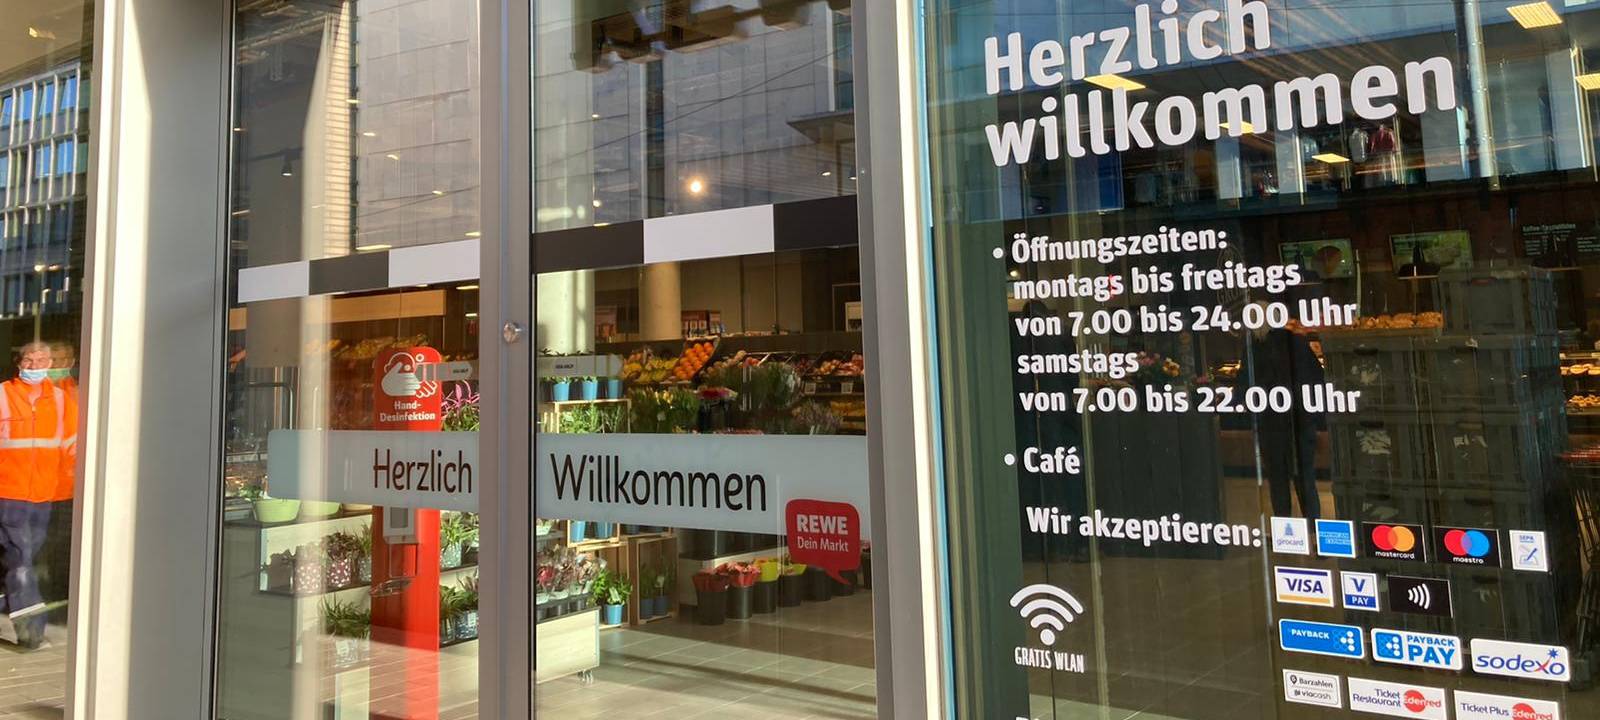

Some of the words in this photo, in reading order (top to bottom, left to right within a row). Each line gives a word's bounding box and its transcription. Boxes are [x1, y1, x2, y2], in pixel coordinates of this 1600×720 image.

[984, 0, 1271, 95] Herzlich
[985, 56, 1456, 167] willkommen
[1011, 226, 1228, 265] Öffnungszeiten:
[1013, 272, 1124, 302] montags
[1131, 267, 1174, 295] bis
[1181, 261, 1302, 293] freitags
[1015, 312, 1061, 337] von
[1068, 310, 1132, 336] 7.00
[1140, 303, 1183, 332] bis
[1191, 303, 1289, 332] 24.00
[1298, 299, 1357, 327] Uhr
[1017, 348, 1140, 379] samstags
[1019, 389, 1066, 412] von
[1073, 388, 1137, 413] 7.00
[1145, 384, 1188, 412] bis
[1196, 384, 1292, 413] 22.00
[1301, 383, 1361, 412] Uhr
[394, 401, 422, 413] Hand-
[379, 412, 436, 423] Desinfektion
[1023, 446, 1081, 474] Café
[372, 448, 473, 494] Herzlich
[550, 453, 767, 511] Willkommen
[796, 513, 849, 535] REWE
[1026, 506, 1071, 535] Wir
[1079, 510, 1262, 547] akzeptieren:
[797, 536, 818, 550] Dein
[820, 538, 849, 552] Markt
[1375, 550, 1415, 560] mastercard
[1453, 556, 1484, 564] maestro
[1285, 577, 1324, 594] VISA
[1353, 578, 1366, 593] V
[1352, 596, 1369, 605] PAY
[1291, 629, 1330, 640] PAYBACK
[1406, 635, 1455, 647] PAYBACK
[1014, 646, 1051, 668] GRATIS
[1054, 651, 1085, 673] WLAN
[1408, 646, 1455, 666] PAY
[1476, 655, 1565, 677] sodexo
[1299, 678, 1333, 689] Barzahlen
[1353, 694, 1401, 707] Restaurant
[1374, 688, 1400, 699] Ticket
[1404, 694, 1442, 708] Edenred
[1461, 703, 1490, 713] Ticket
[1492, 706, 1509, 717] Plus
[1512, 709, 1553, 719] Edenred
